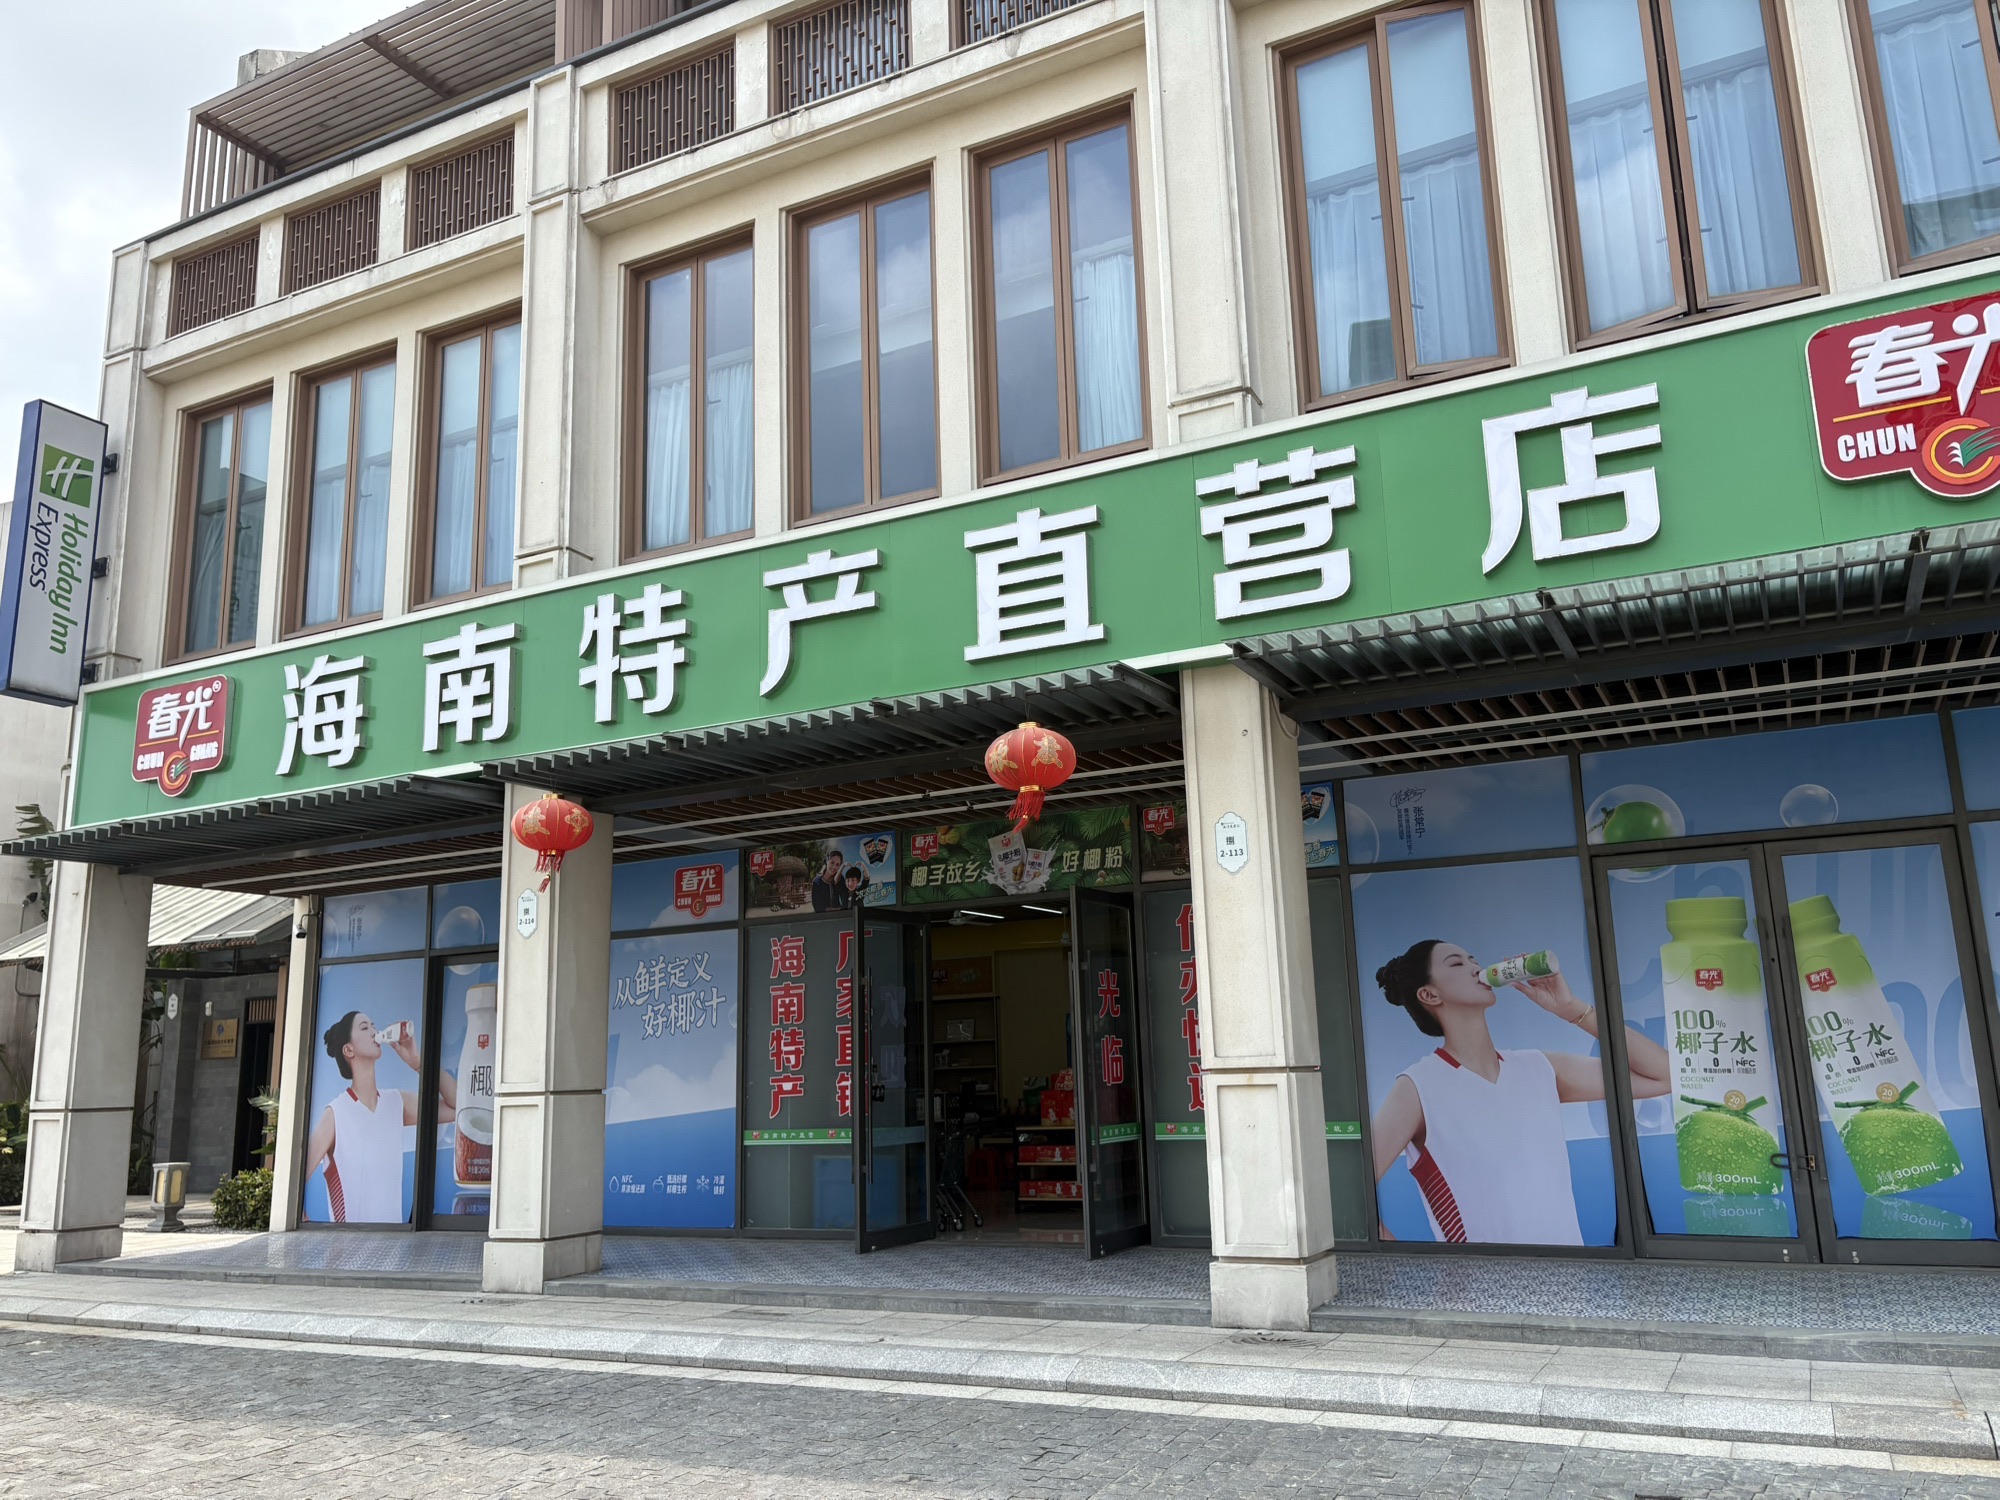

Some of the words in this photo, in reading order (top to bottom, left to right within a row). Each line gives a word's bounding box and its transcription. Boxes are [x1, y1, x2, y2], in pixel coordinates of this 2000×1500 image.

[1837, 422, 1917, 463] CHUN
[29, 501, 59, 592] Express
[48, 512, 89, 612] Holiday
[275, 382, 1662, 776] 海南特产直营店
[49, 612, 79, 655] Inn
[147, 686, 215, 750] 春光
[136, 751, 165, 771] CHUN
[1147, 808, 1169, 823] 春光
[1413, 805, 1426, 838] 张常宁
[915, 834, 934, 850] 春光
[1220, 848, 1244, 858] 2-113
[753, 853, 770, 866] 春光
[1061, 846, 1123, 873] 好椰粉
[680, 868, 716, 895] 春光
[911, 861, 981, 887] 椰子故乡
[519, 917, 534, 925] 2-114
[612, 952, 713, 1009] 从鲜定义
[1699, 969, 1720, 982] 春光
[1809, 970, 1830, 983] 春光
[642, 986, 727, 1041] 好椰汁
[1671, 1009, 1727, 1030] 100%
[1806, 1011, 1855, 1038] 00%
[769, 934, 806, 1119] 海南特产
[1097, 968, 1125, 1087] 光临
[1675, 1030, 1758, 1055] 椰子水
[1808, 1022, 1893, 1063] 椰子水
[1875, 1048, 1896, 1059] NFC
[1735, 1057, 1756, 1067] NFC
[1882, 1087, 1893, 1097] 20
[621, 1174, 633, 1183] NFC
[1715, 1173, 1762, 1184] 300mL
[1894, 1161, 1941, 1179] 300mL
